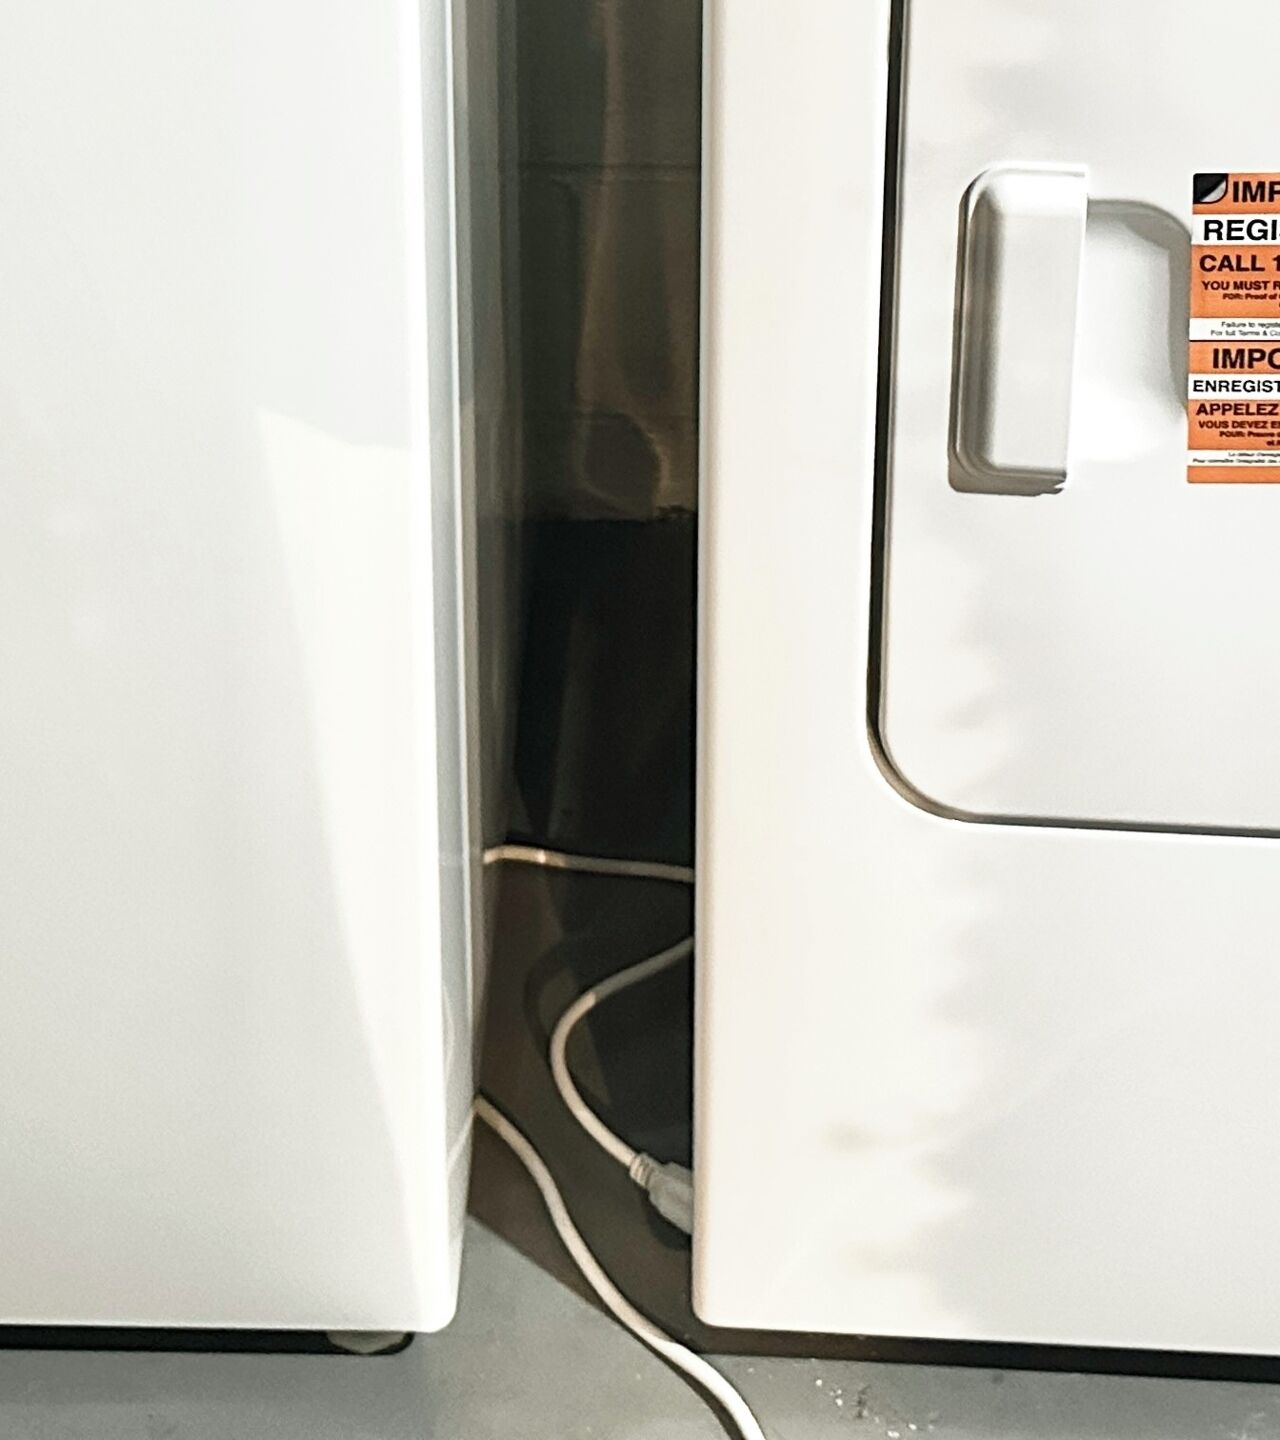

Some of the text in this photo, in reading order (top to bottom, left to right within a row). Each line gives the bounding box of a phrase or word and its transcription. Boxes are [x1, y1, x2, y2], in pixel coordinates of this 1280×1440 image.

[1199, 255, 1266, 272] CALL
[1202, 280, 1230, 291] YOU
[1233, 280, 1270, 291] MUST
[1222, 293, 1243, 301] FOR:
[1245, 293, 1268, 301] Proof
[1221, 321, 1247, 329] Failure
[1210, 329, 1222, 338] For
[1238, 329, 1260, 338] Terms
[1195, 403, 1279, 417] APPELEZ
[1198, 421, 1230, 430] VOUS
[1231, 421, 1268, 430] DEVEZ
